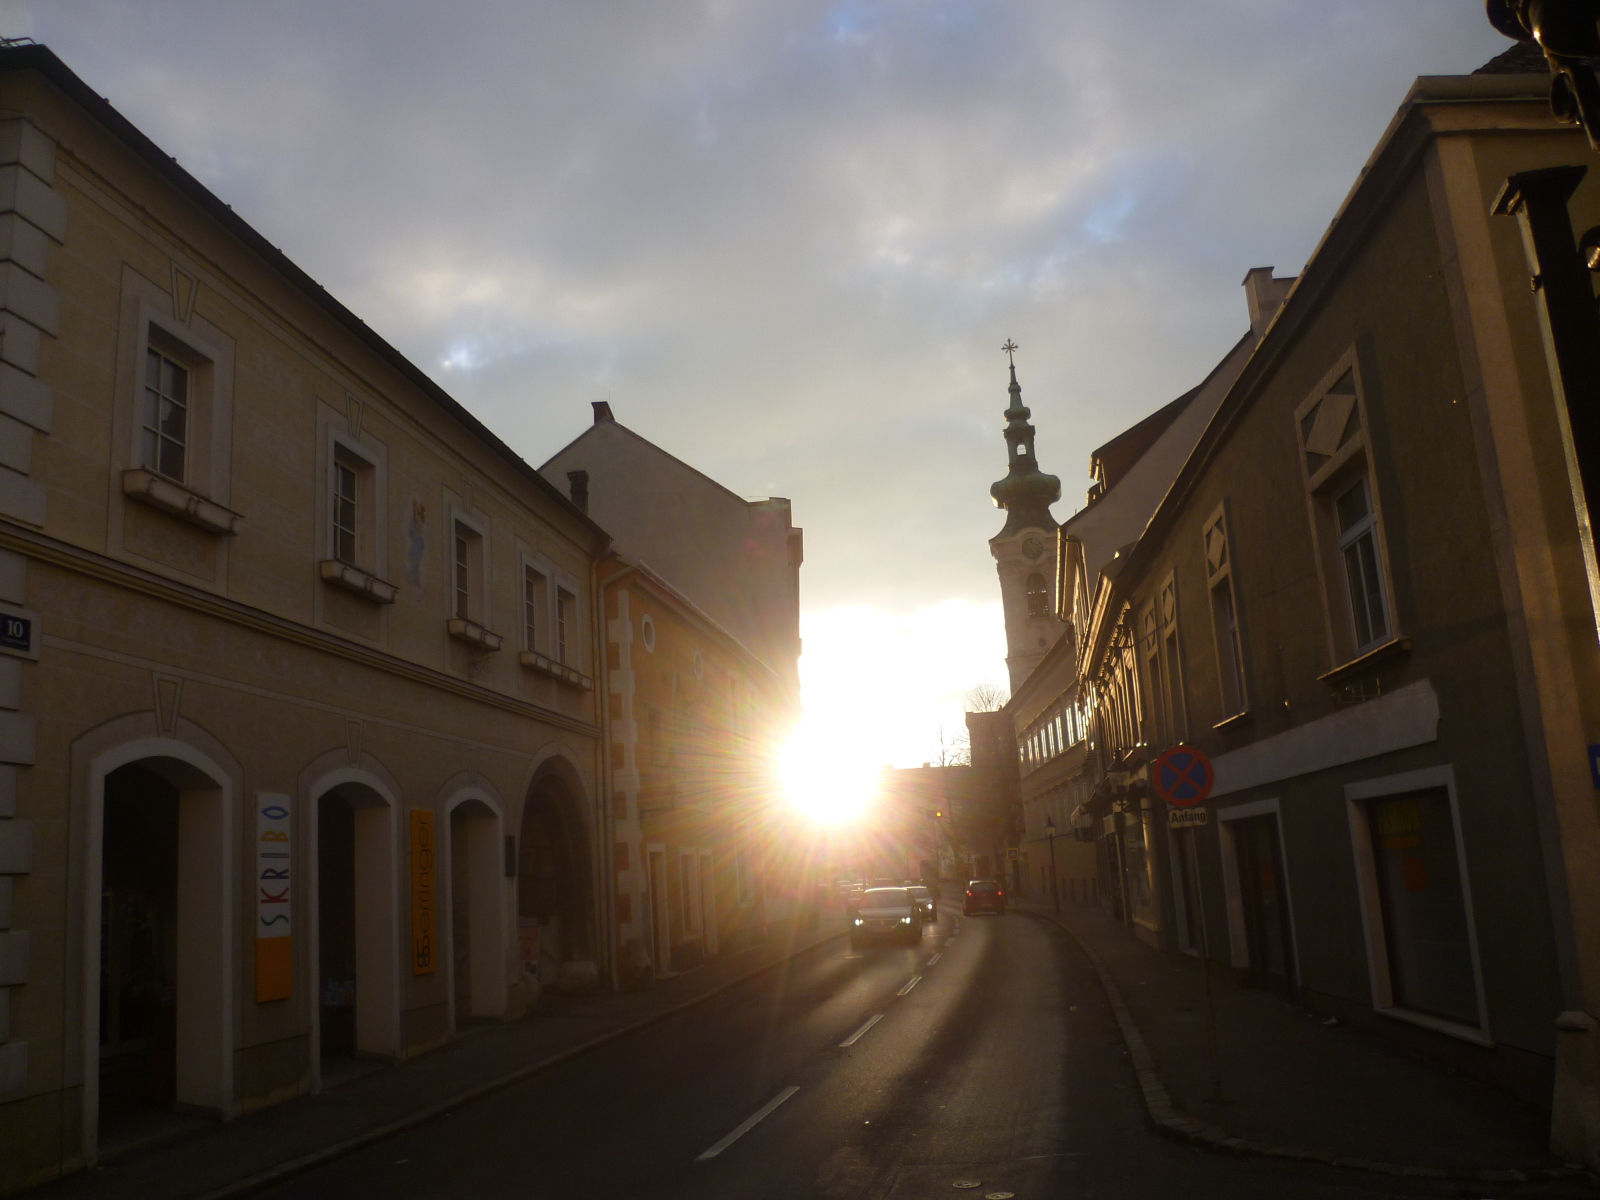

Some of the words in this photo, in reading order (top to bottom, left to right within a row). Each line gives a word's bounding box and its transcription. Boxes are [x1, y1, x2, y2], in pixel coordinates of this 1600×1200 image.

[8, 620, 24, 638] 10
[1171, 811, 1207, 824] Anfang
[260, 805, 290, 927] SKRIBO
